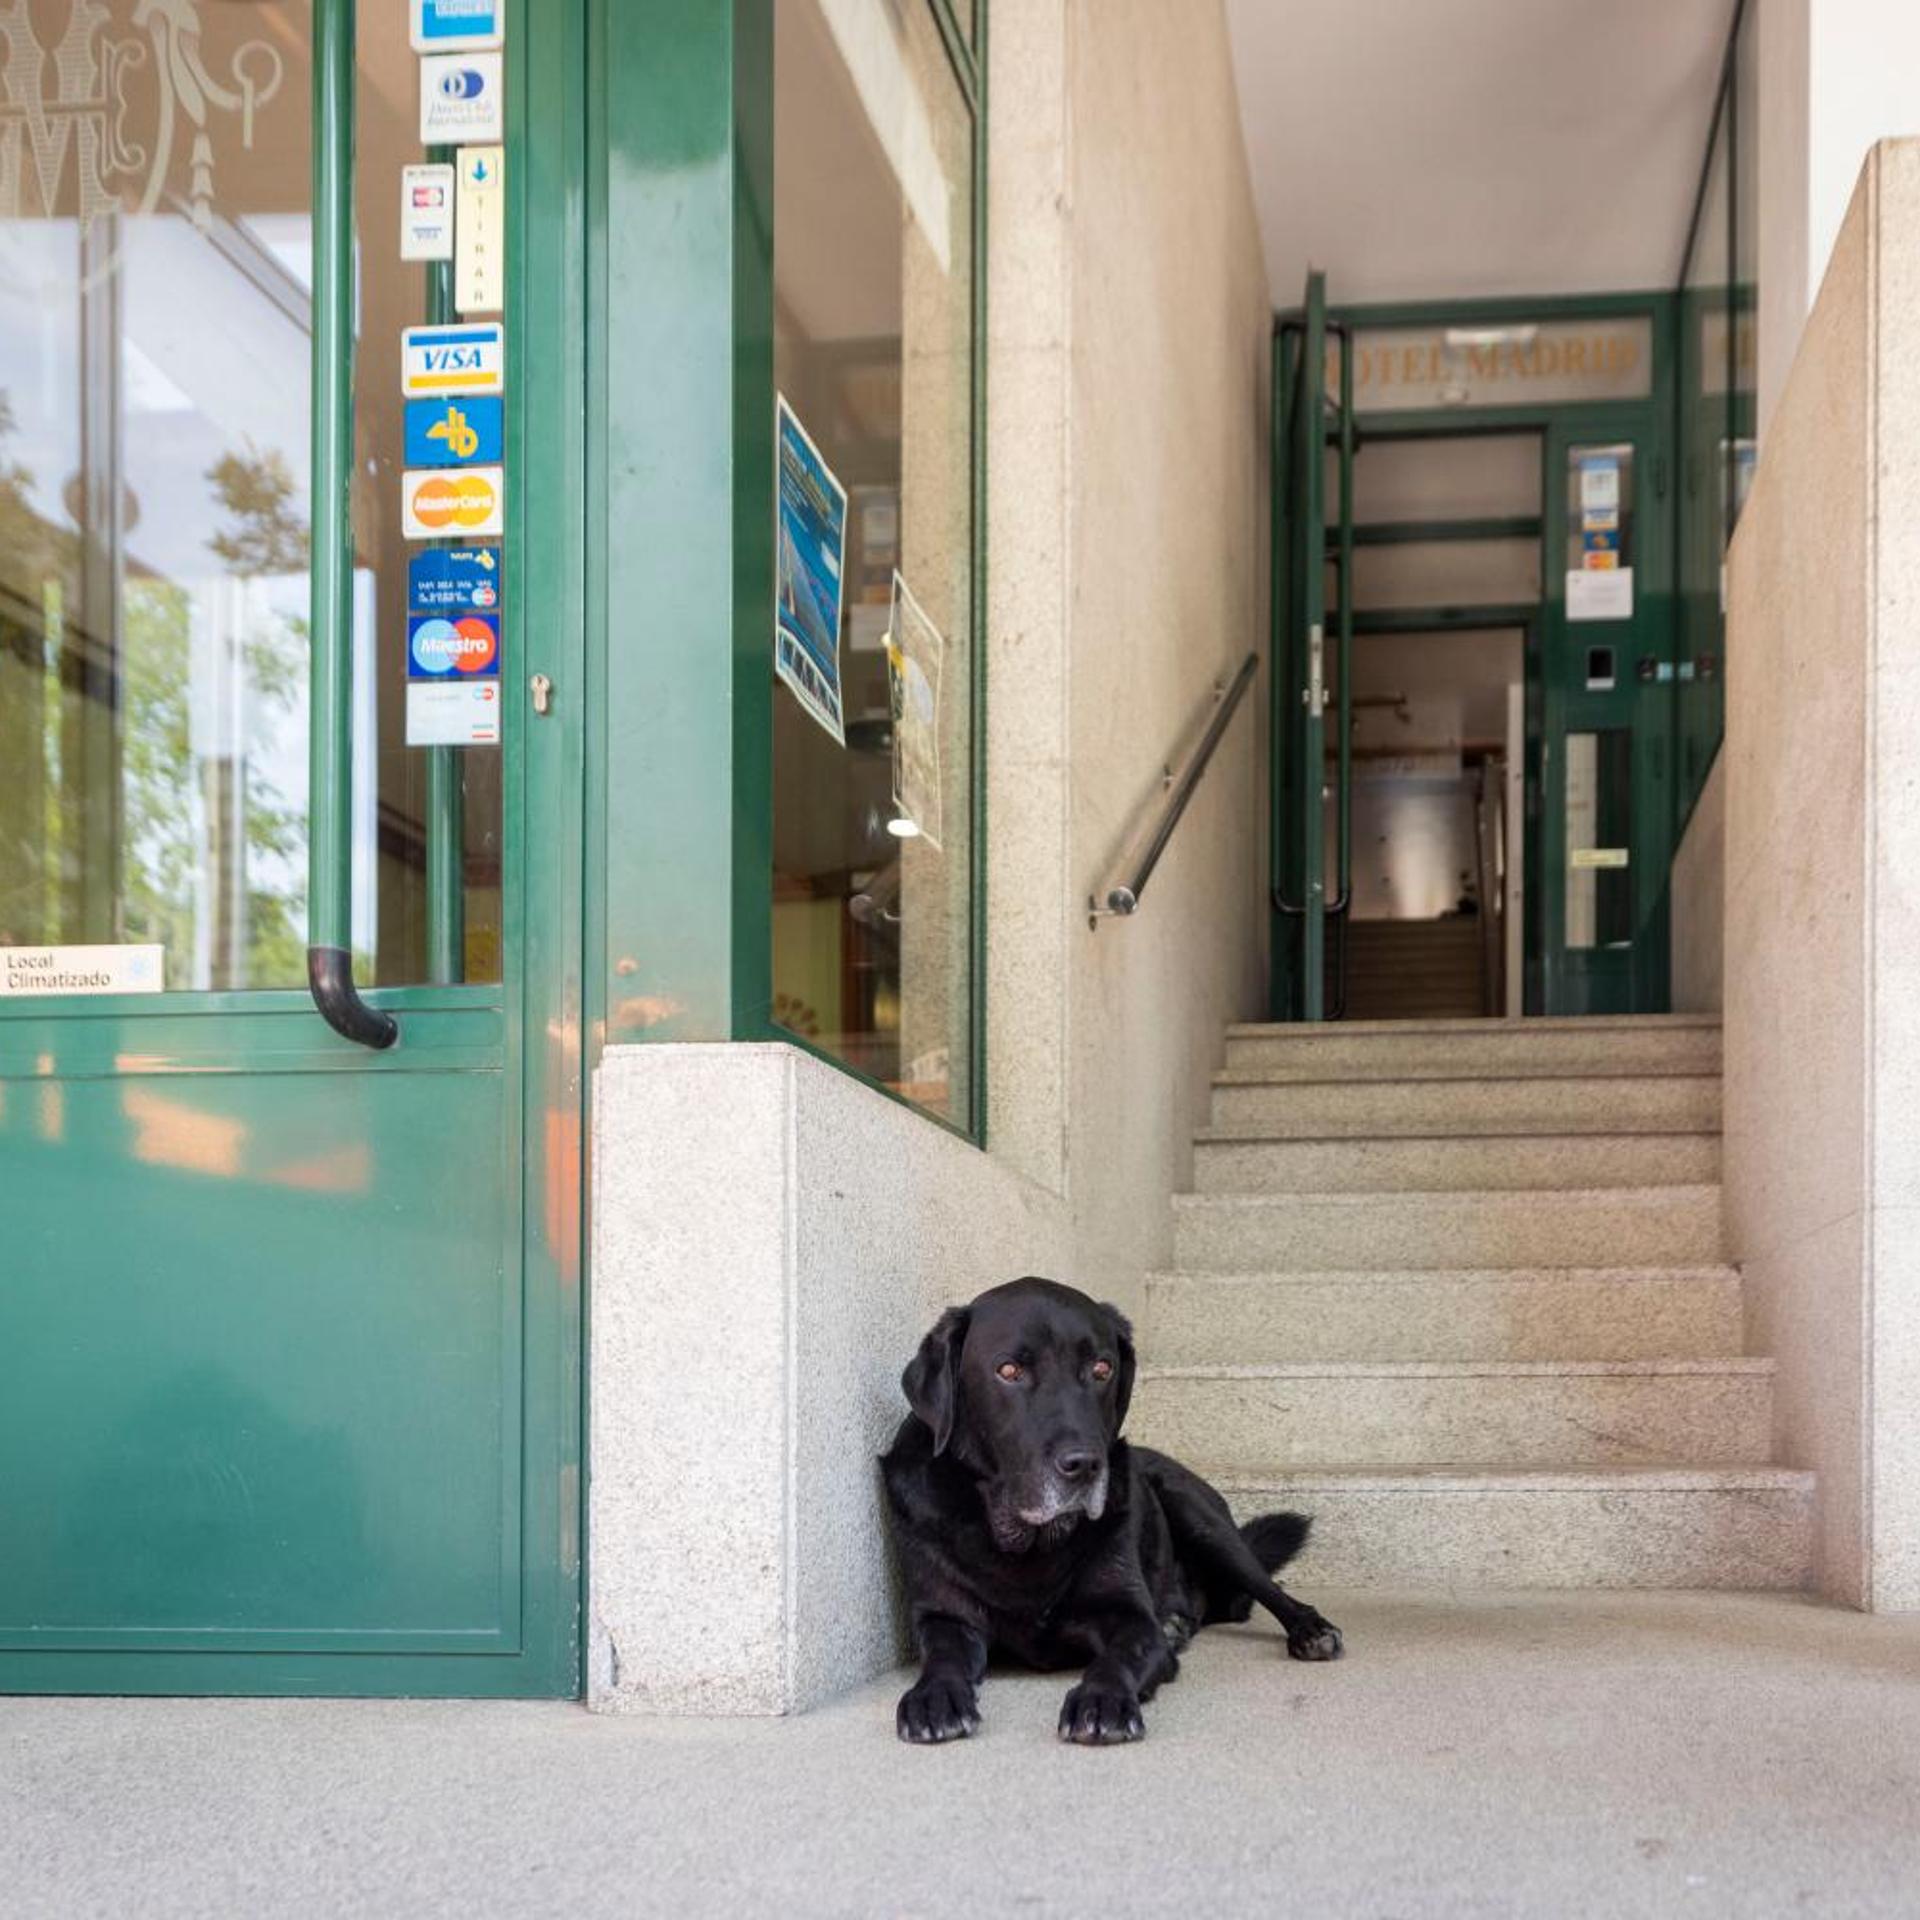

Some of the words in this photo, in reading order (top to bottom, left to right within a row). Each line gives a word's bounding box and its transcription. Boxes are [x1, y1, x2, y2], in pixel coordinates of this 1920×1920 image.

[424, 348, 482, 370] VISA
[419, 637, 489, 655] Maestro
[7, 954, 54, 969] Local
[8, 970, 111, 988] Climatizado
